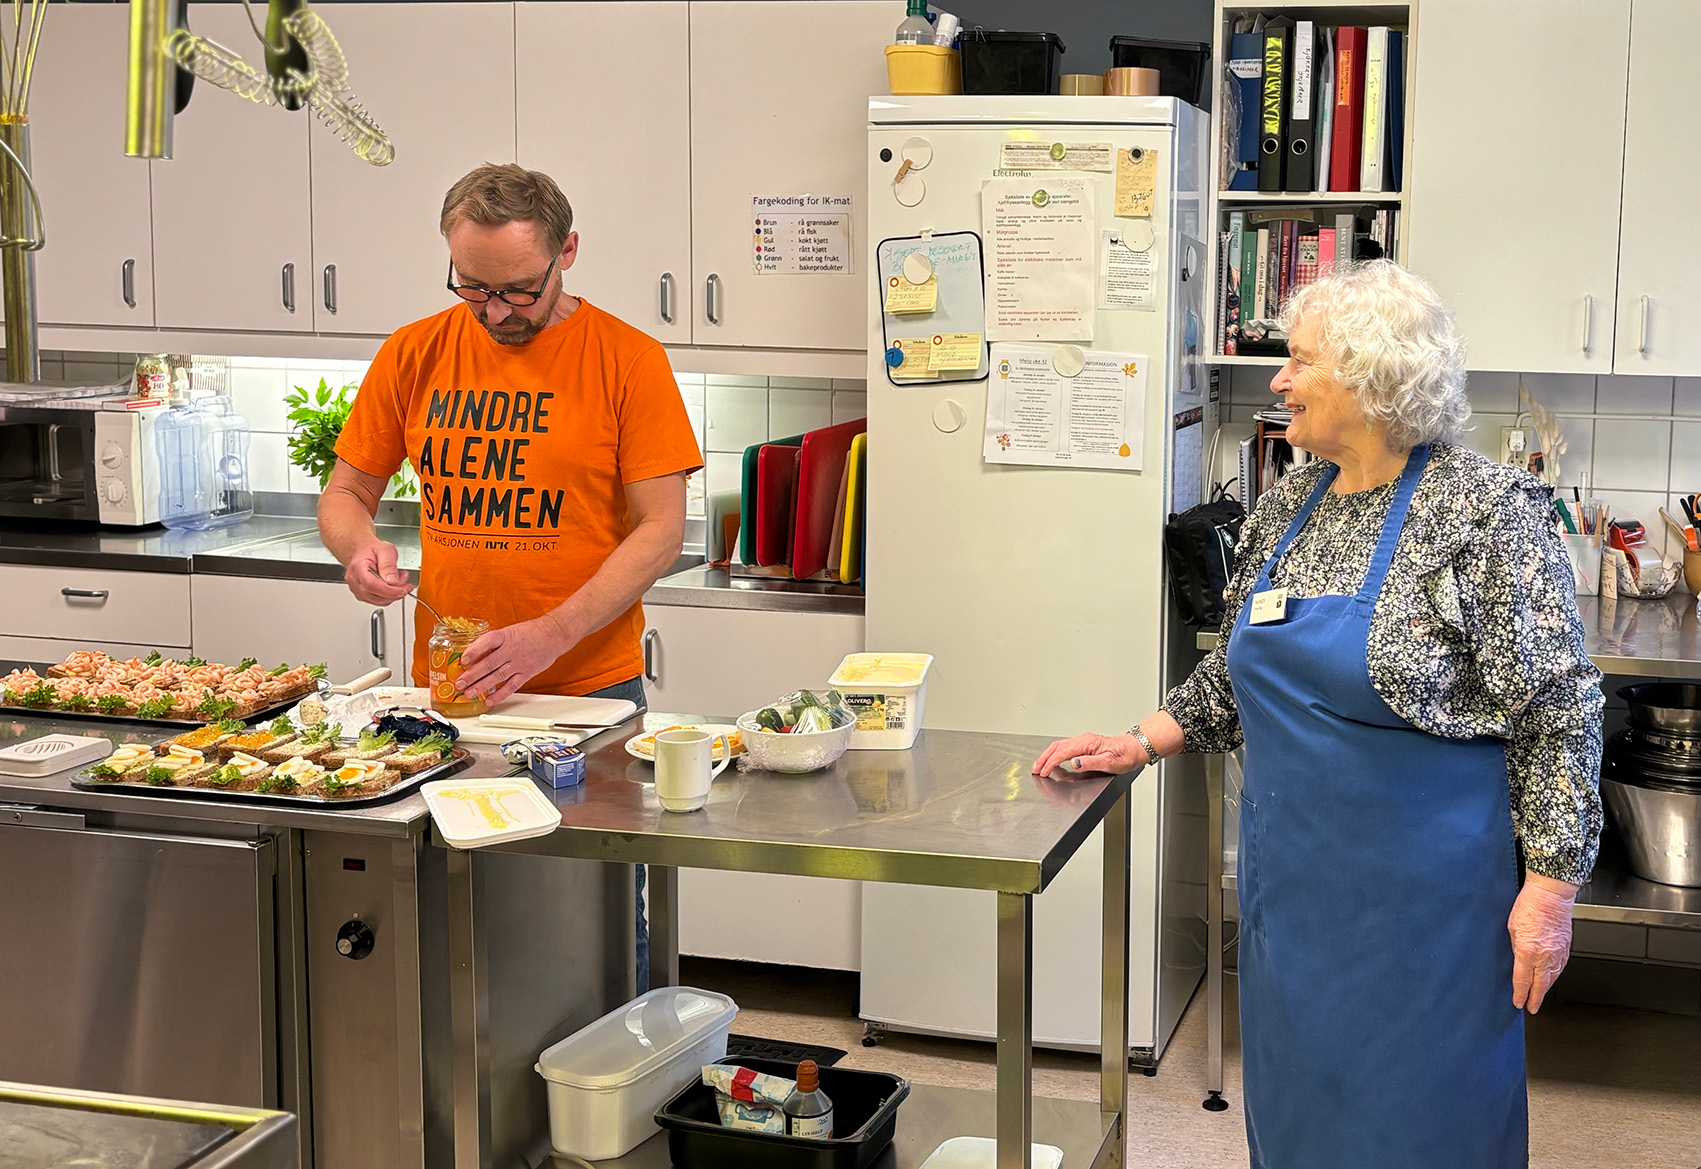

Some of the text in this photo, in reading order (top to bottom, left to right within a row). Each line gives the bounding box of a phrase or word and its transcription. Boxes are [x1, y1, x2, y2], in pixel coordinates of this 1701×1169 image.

[753, 196, 851, 206] Fargekoding for IK-mat
[806, 219, 840, 227] grønnsaker
[813, 237, 829, 245] kjøtt
[812, 246, 827, 254] kjøtt
[799, 264, 843, 272] bakeprodukter
[425, 388, 554, 433] MINDRE
[420, 436, 530, 481] ALENE
[423, 482, 565, 529] SAMMEN
[515, 542, 531, 551] 21.
[533, 542, 558, 551] OKT.
